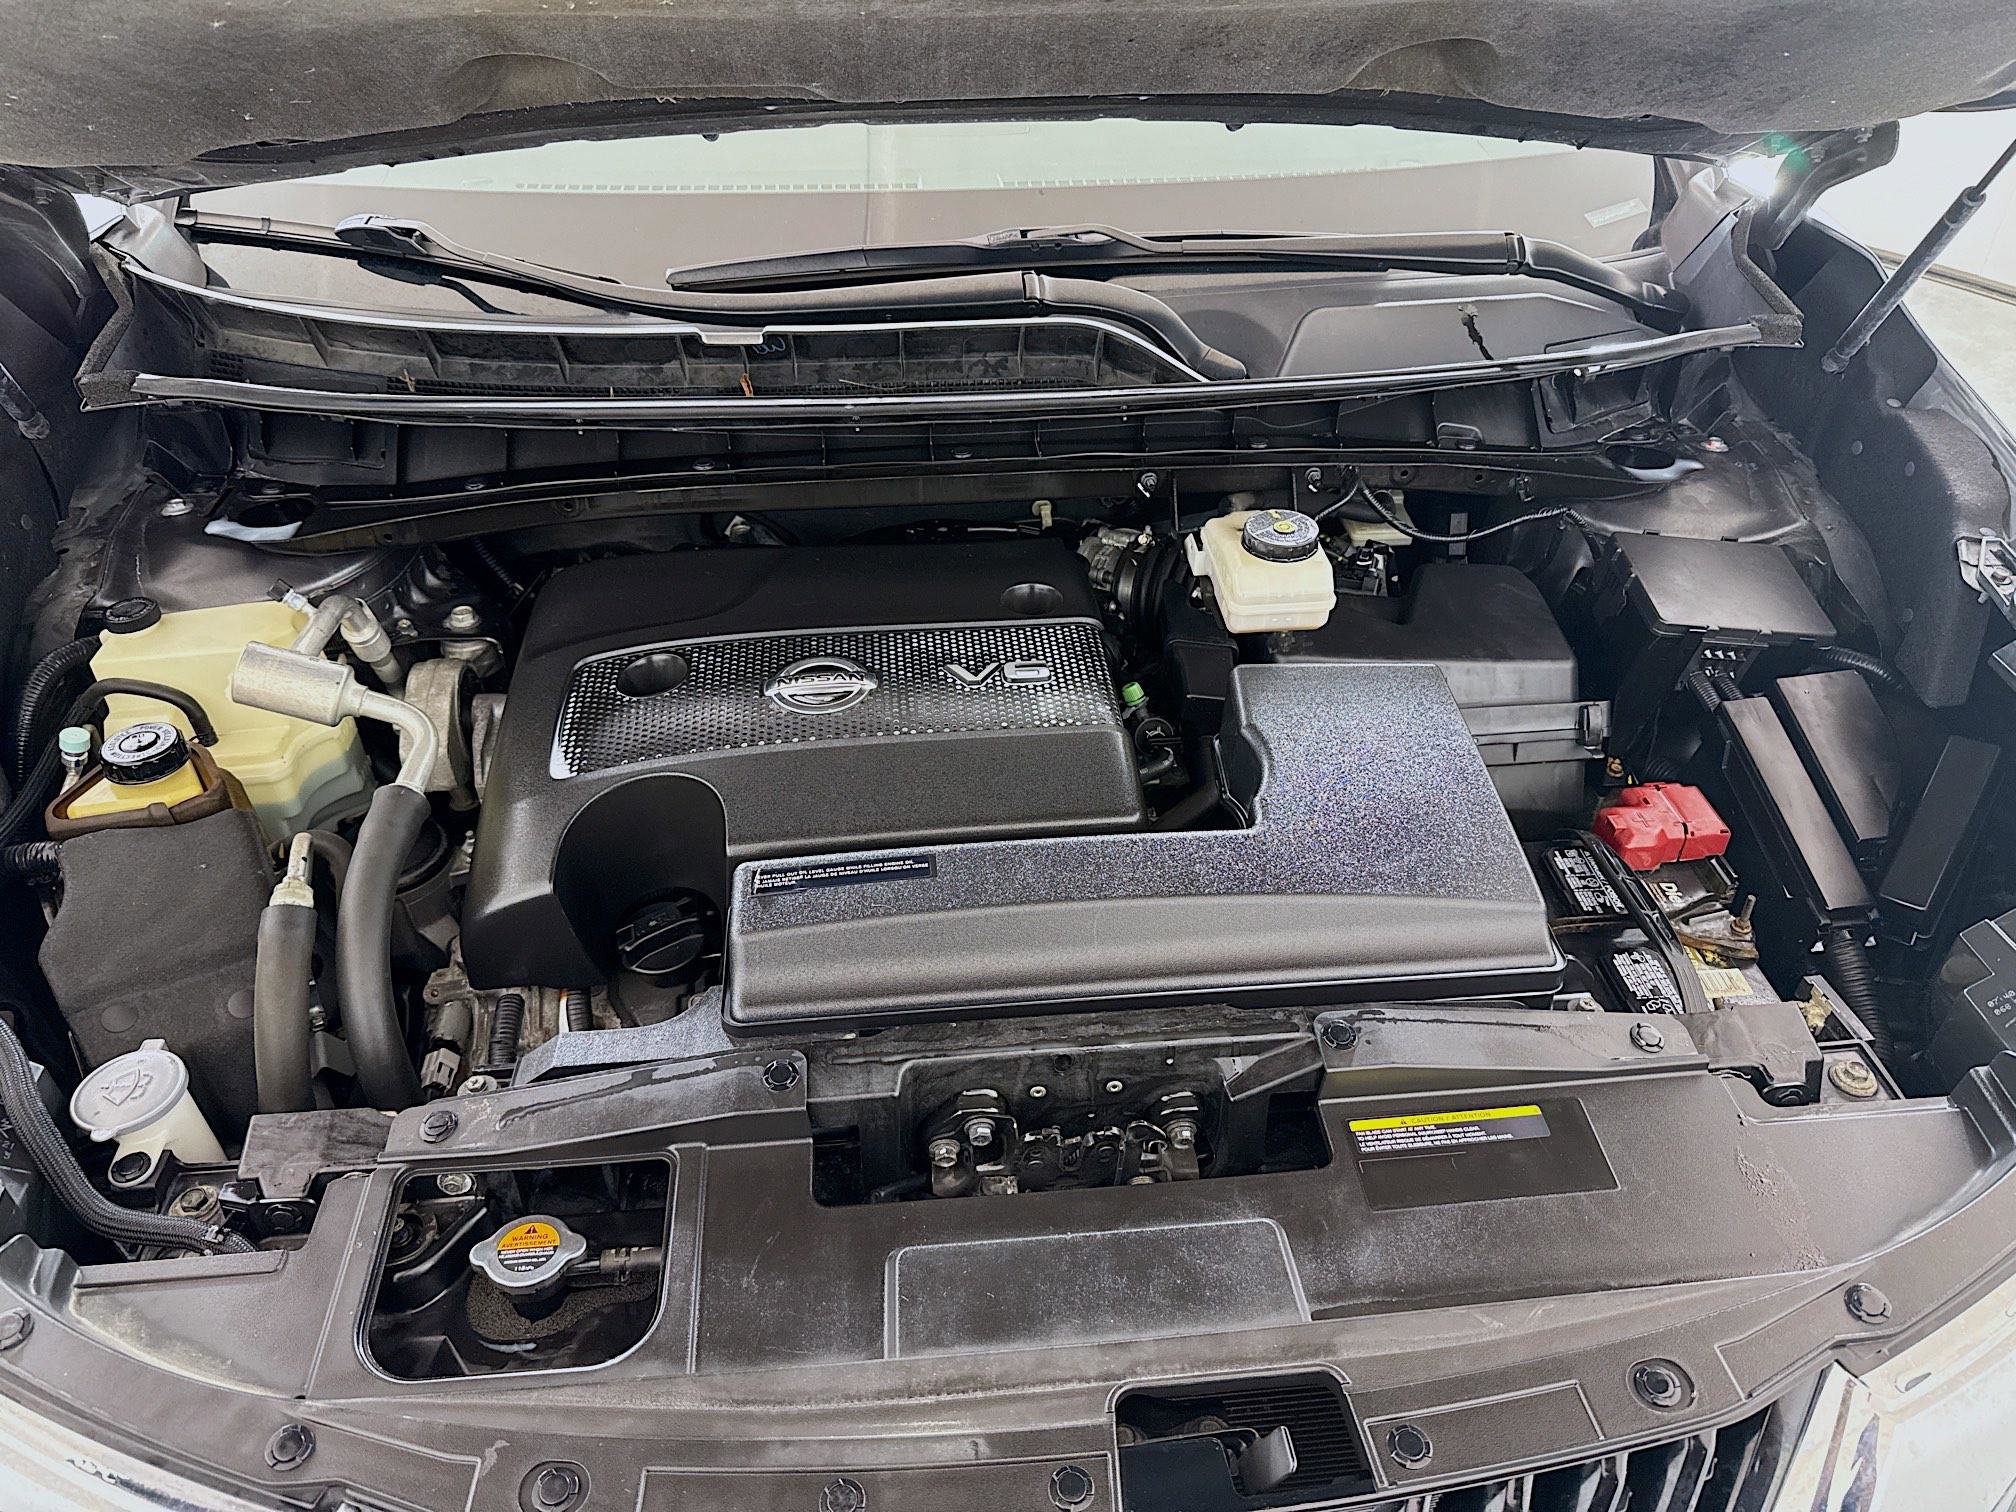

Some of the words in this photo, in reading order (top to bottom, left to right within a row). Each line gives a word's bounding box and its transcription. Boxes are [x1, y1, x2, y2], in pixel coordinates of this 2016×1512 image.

[777, 671, 865, 686] NISSAN
[943, 659, 1052, 688] V6
[1411, 1114, 1444, 1124] CAUTION
[1452, 1112, 1491, 1120] ATTENTION
[502, 1239, 556, 1248] AVERTISSEMENT
[512, 1234, 549, 1242] WARNING
